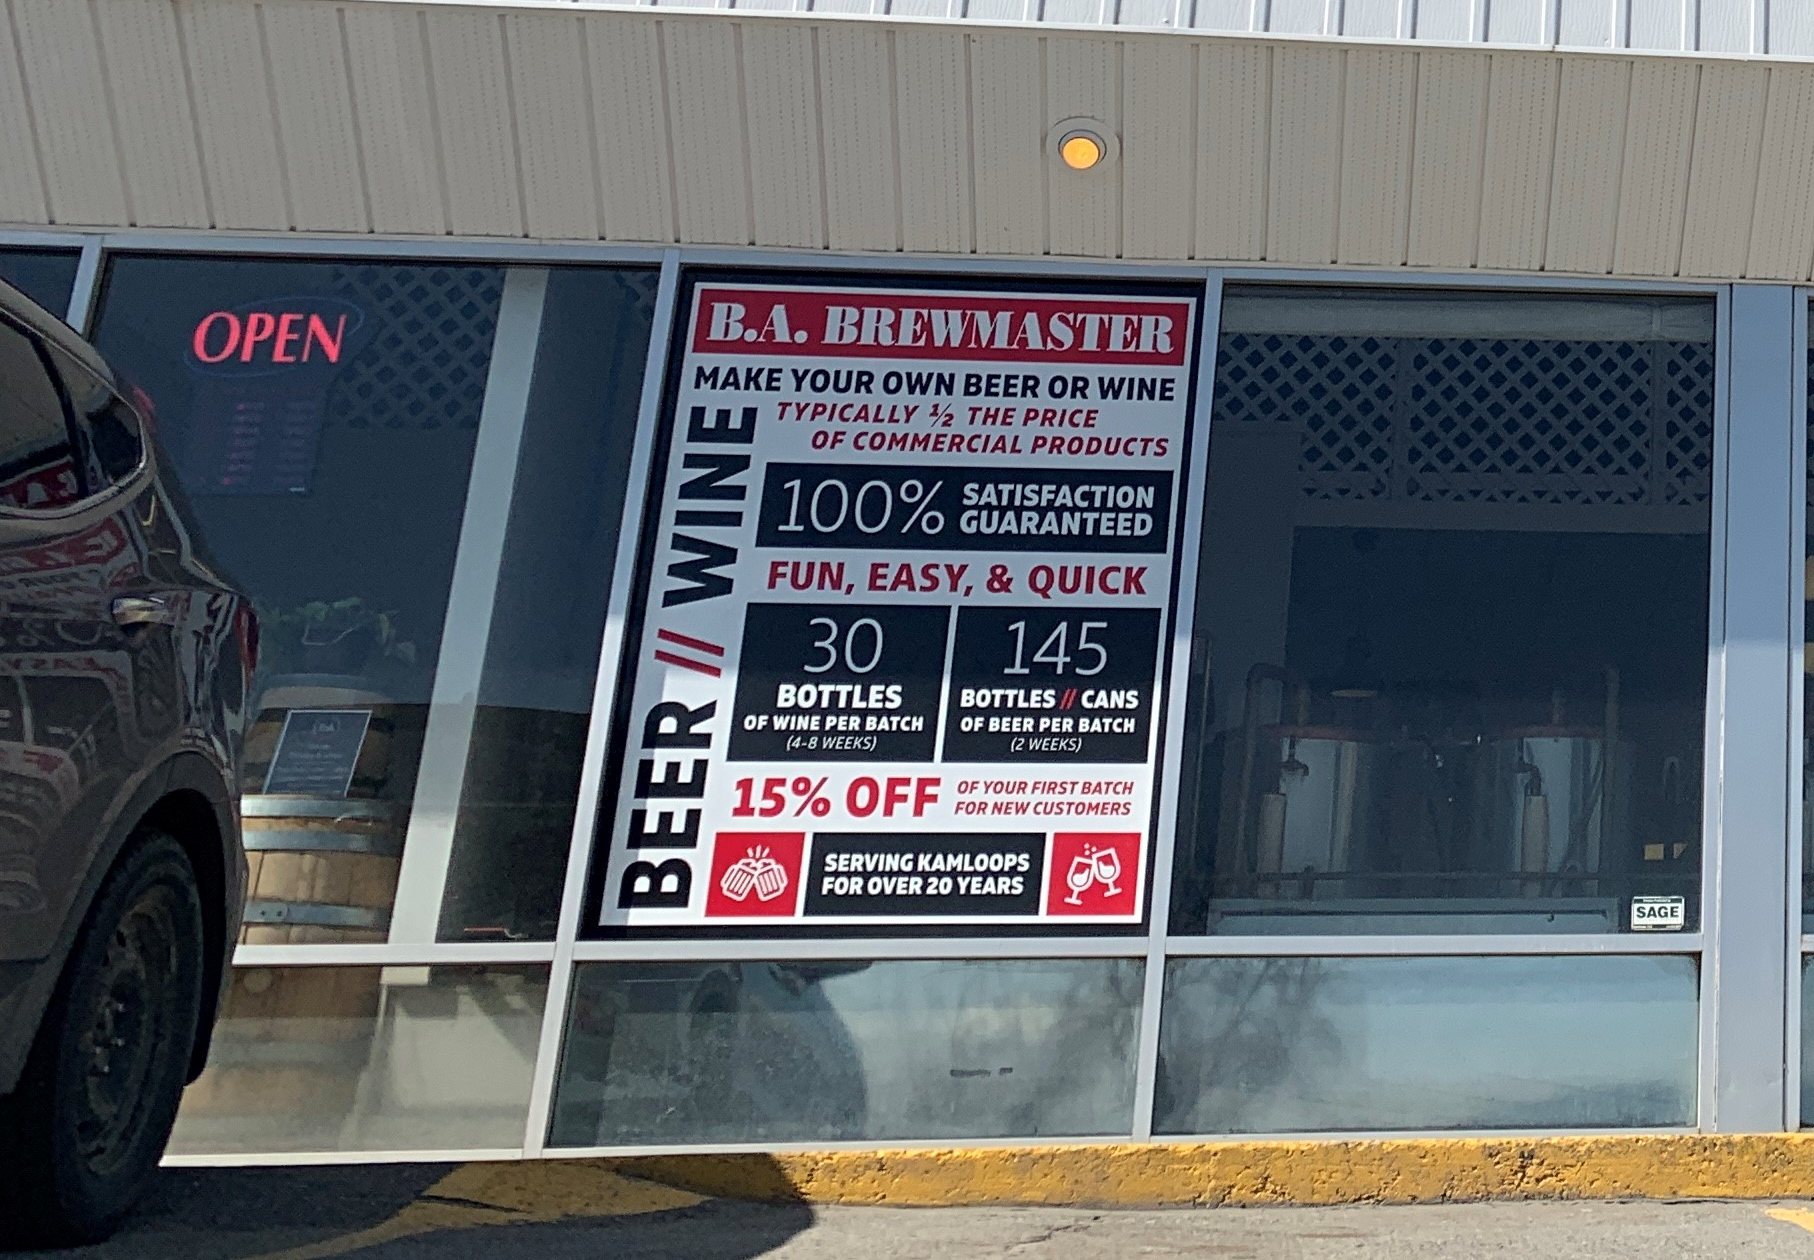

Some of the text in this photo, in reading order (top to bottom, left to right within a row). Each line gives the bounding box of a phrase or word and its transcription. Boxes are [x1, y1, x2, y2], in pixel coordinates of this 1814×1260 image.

[193, 311, 348, 363] OPEN
[706, 301, 1174, 354] B.A. BREWMASTER
[694, 365, 1176, 401] MAKE YOUR OWN BEER OR WINE
[777, 401, 919, 424] TYPICALLY
[968, 406, 1017, 426] THE
[1022, 408, 1099, 428] PRICE
[811, 430, 1169, 457] OF COMMERCIAL PRODUCTS
[662, 406, 758, 608] WINE
[777, 479, 946, 535] 100%
[962, 483, 1155, 508] SATISFACTION
[959, 510, 1154, 536] GUARANTEED
[767, 561, 1149, 599] FUN, EASY, & QUICK
[803, 617, 883, 673] 30
[1003, 621, 1108, 675] 145
[776, 684, 903, 709] BOTTLES
[959, 689, 1056, 708] BOTTLES
[1081, 690, 1139, 709] CANS
[743, 715, 924, 732] OF WINE PER BATCH
[960, 716, 1136, 733] OF BEER PER BATCH
[786, 735, 877, 751] (4-8 WEEKS)
[1010, 737, 1082, 753] (2 WEEKS)
[732, 776, 942, 818] 15% OFF
[957, 781, 1135, 796] OF YOUR FIRST BATCH
[617, 699, 718, 909] BEER
[954, 801, 1132, 816] FOR NEW CUSTOMERS
[824, 853, 1030, 872] SERVING KAMLOOPS
[821, 876, 1024, 895] FOR OVER 20 YEARS
[1636, 905, 1680, 919] SAGE
